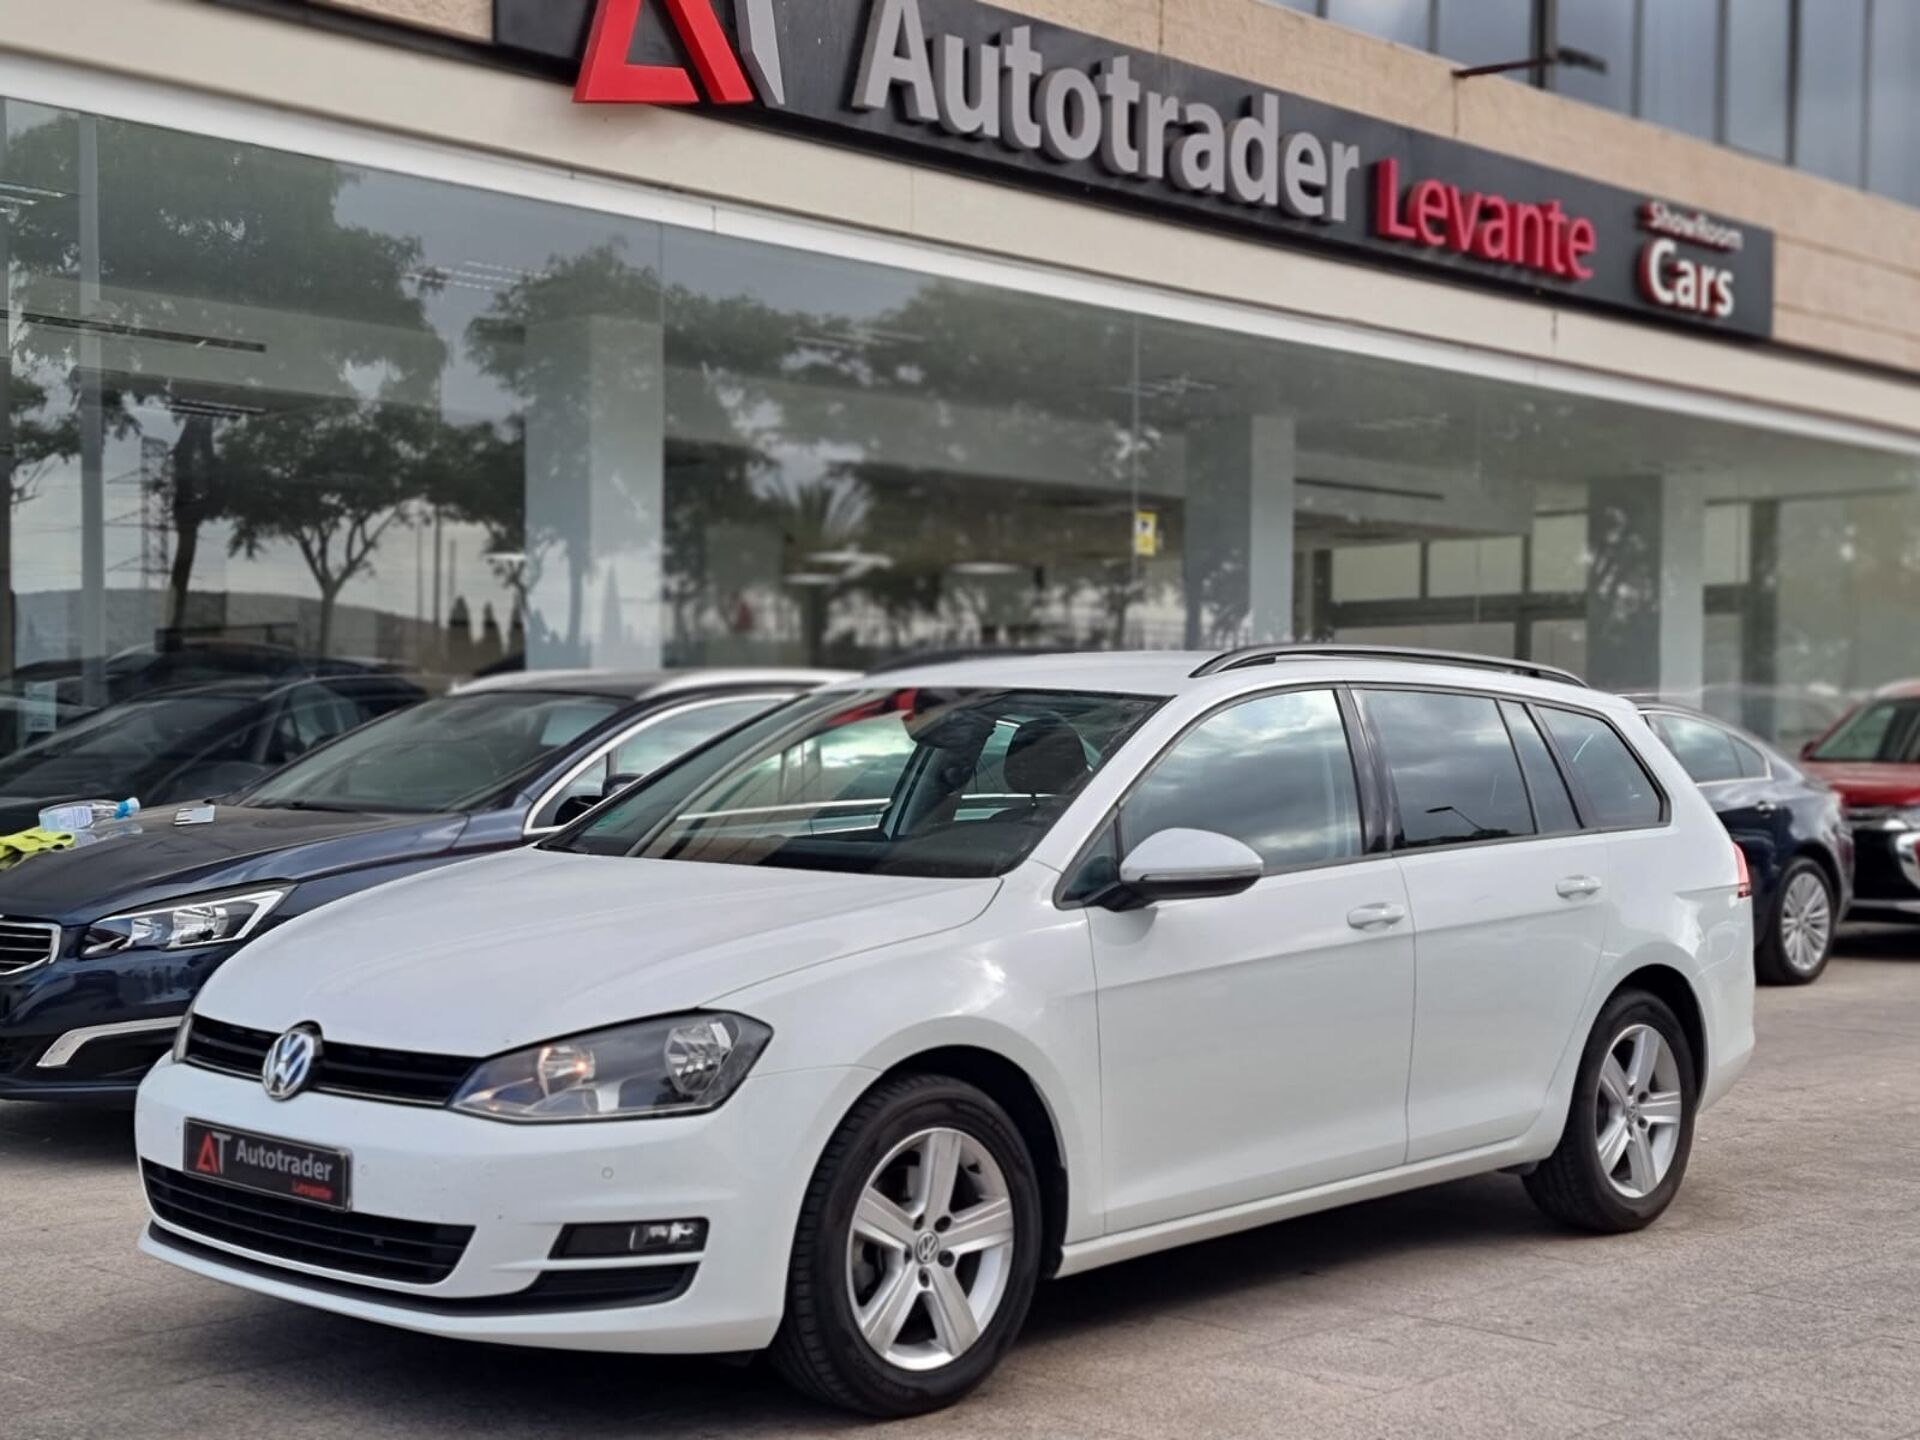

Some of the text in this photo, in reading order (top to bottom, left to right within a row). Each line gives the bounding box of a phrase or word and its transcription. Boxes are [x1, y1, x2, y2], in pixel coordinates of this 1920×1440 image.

[853, 0, 1597, 281] Autotrader Levante
[1643, 237, 1735, 317] Cars
[235, 1139, 333, 1181] Autotrader
